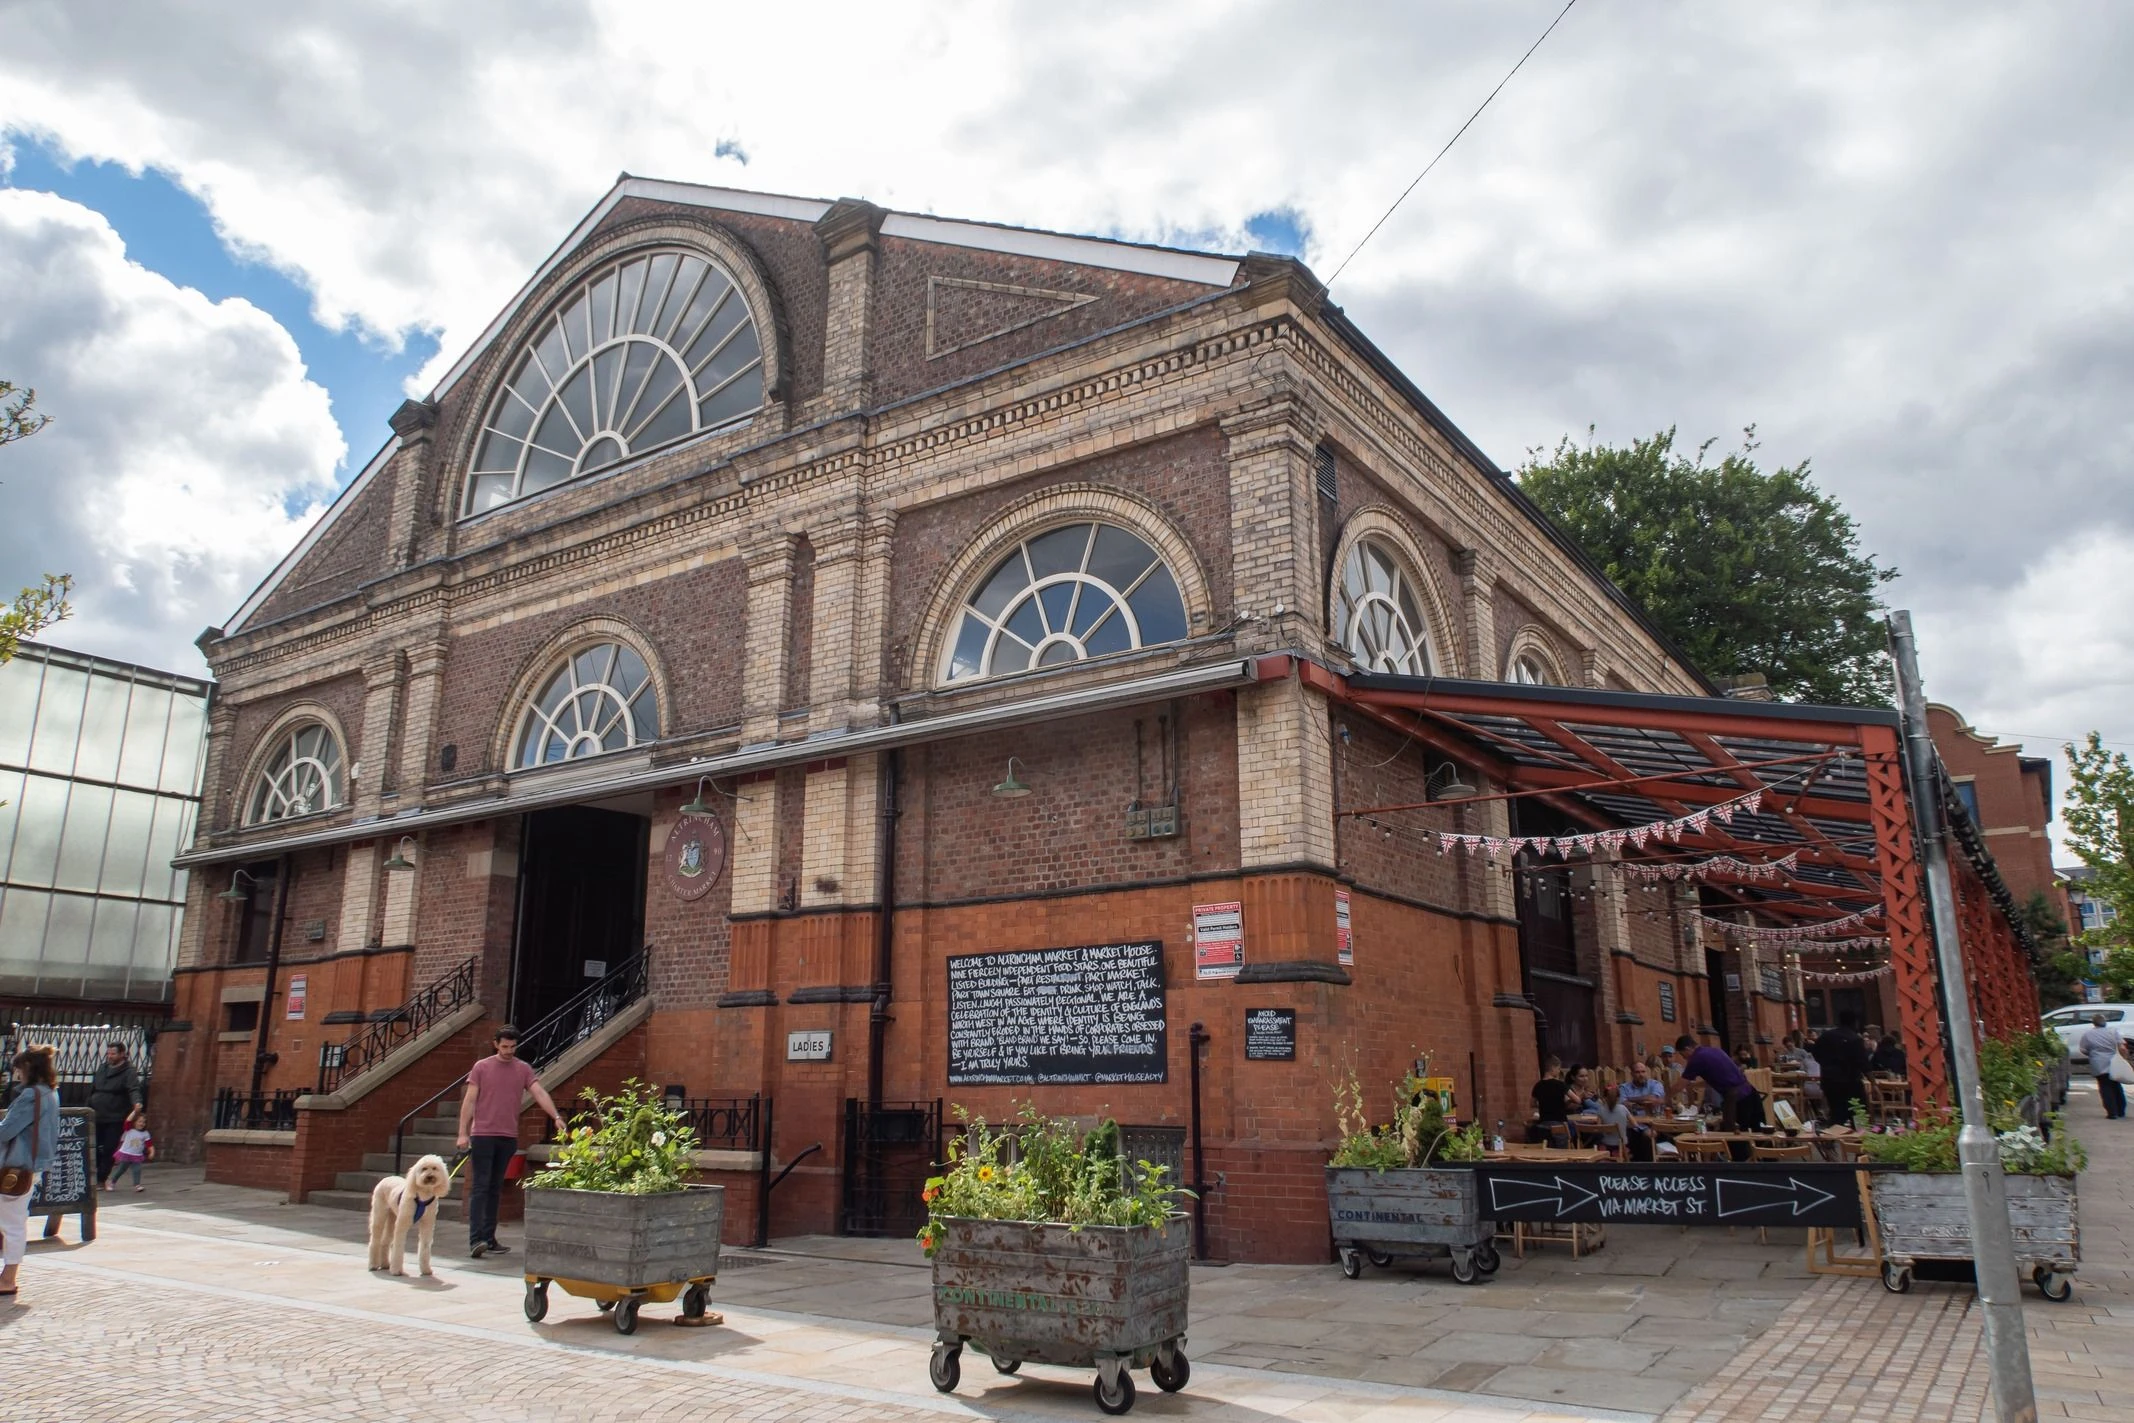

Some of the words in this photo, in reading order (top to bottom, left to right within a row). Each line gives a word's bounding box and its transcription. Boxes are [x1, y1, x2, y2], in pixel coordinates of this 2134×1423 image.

[692, 871, 717, 897] MARKET
[1215, 903, 1239, 911] PROPERTY
[950, 958, 983, 969] WELCOME
[985, 956, 995, 966] TO
[998, 952, 1044, 965] ALTRINCHAM
[1044, 949, 1081, 961] MARKET
[1082, 949, 1088, 961] &
[1089, 946, 1123, 959] MARKET
[951, 969, 967, 980] NINE
[968, 967, 1002, 979] FIERCELY
[1003, 963, 1054, 976] INDEPENDENT
[1054, 962, 1073, 973] FOOD
[1101, 960, 1117, 970] ONE
[1117, 956, 1159, 968] BEAUTIFUL
[951, 981, 977, 990] LISTED
[1085, 971, 1107, 983] PART
[952, 990, 971, 1001] PART
[971, 989, 990, 999] TOWN
[980, 998, 1003, 1009] LAUGH
[1005, 995, 1054, 1010] PASSIONATELY
[1101, 993, 1116, 1002] WE
[1117, 991, 1136, 1002] ARE
[1139, 990, 1147, 1001] A
[951, 1008, 999, 1020] CELEBRATION
[1000, 1007, 1010, 1017] OF
[1012, 1006, 1028, 1017] THE
[1030, 1004, 1062, 1019] IDENTITY
[1064, 1006, 1071, 1016] &
[1072, 1003, 1109, 1015] CULTURE
[1111, 1002, 1120, 1012] OF
[1258, 1009, 1277, 1017] AVOID
[950, 1028, 991, 1040] CONSTANTLY
[992, 1025, 1021, 1037] ERODED
[1023, 1026, 1031, 1035] IN
[1031, 1025, 1046, 1036] THE
[1048, 1023, 1073, 1035] HANDS
[1075, 1024, 1084, 1034] OF
[1085, 1022, 1131, 1035] CORPORATES
[1131, 1019, 1165, 1032] OBSESSED
[952, 1020, 975, 1030] NORTH
[975, 1018, 997, 1028] WEST
[998, 1018, 1005, 1027] IN
[1006, 1016, 1017, 1026] AN
[1018, 1016, 1036, 1025] AGE
[1037, 1015, 1065, 1026] WHERE
[1066, 1014, 1099, 1027] IDENTITY
[1102, 1013, 1111, 1023] IS
[1114, 1012, 1146, 1023] BEING
[1253, 1023, 1281, 1032] PLEASE
[793, 1041, 824, 1052] LADIES
[951, 1039, 969, 1049] WITH
[1039, 1034, 1051, 1044] WE
[1091, 1034, 1119, 1047] PLEASE
[1121, 1033, 1143, 1044] COME
[952, 1048, 962, 1060] BE
[963, 1046, 997, 1060] YOURSELF
[998, 1046, 1005, 1057] &
[1006, 1045, 1014, 1056] IF
[1015, 1045, 1029, 1058] YOU
[1030, 1045, 1048, 1056] LIKE
[1049, 1045, 1059, 1056] IT
[1060, 1044, 1087, 1056] BRING
[1087, 1044, 1113, 1058] YOUR
[968, 1060, 980, 1070] AM
[980, 1059, 1001, 1071] TRULY
[1599, 1175, 1651, 1194] PLEASE
[1654, 1176, 1706, 1194] ACCESS
[1598, 1198, 1623, 1217] VIA
[1623, 1197, 1682, 1216] MARKET
[1338, 1210, 1425, 1223] CONTINENTAL
[939, 1287, 1060, 1313] CONTINENTAL
